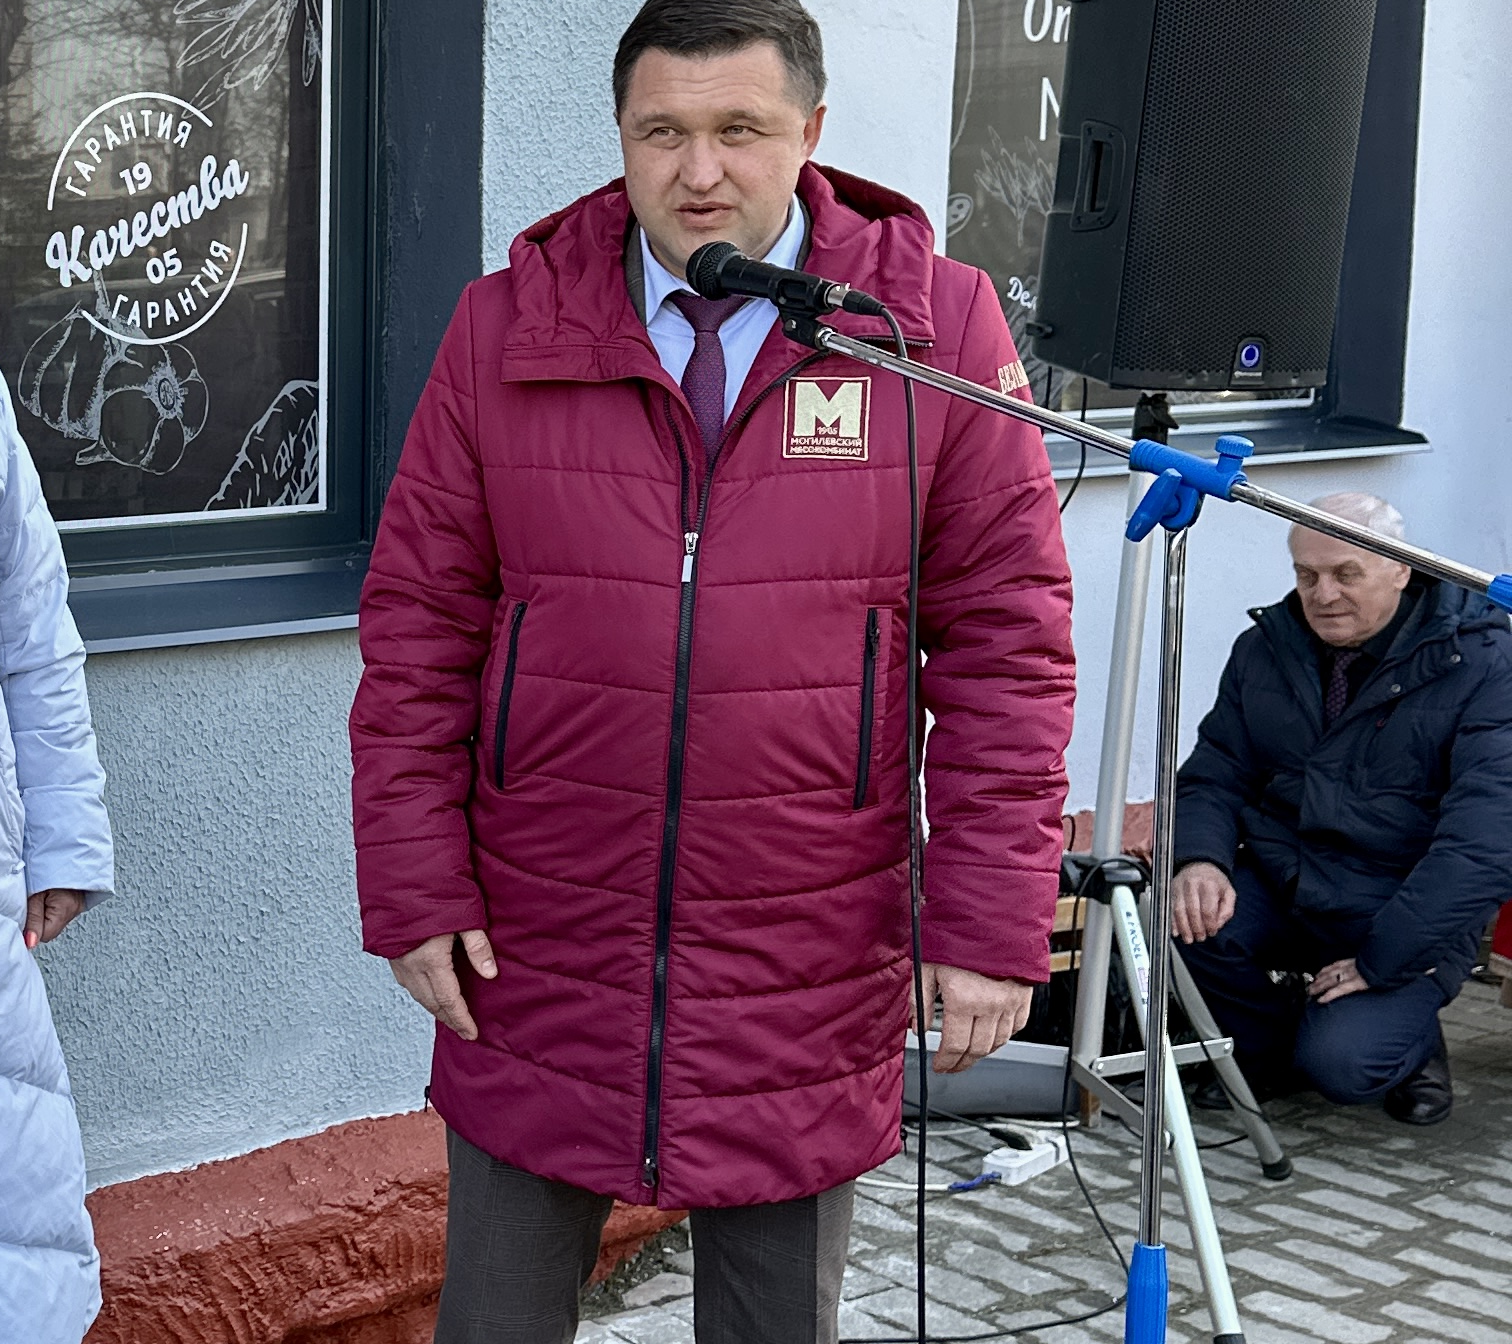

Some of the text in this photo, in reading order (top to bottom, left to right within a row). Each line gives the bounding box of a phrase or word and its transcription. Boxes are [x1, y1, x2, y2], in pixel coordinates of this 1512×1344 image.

[65, 109, 192, 197] ГАРАНТИЯ
[119, 161, 153, 196] 19
[45, 155, 250, 288] Качества
[111, 240, 232, 328] ГАРАНТИЯ
[146, 248, 183, 284] 05
[793, 381, 863, 438] М
[790, 436, 863, 448] МОГИЛЕВСКИЙ
